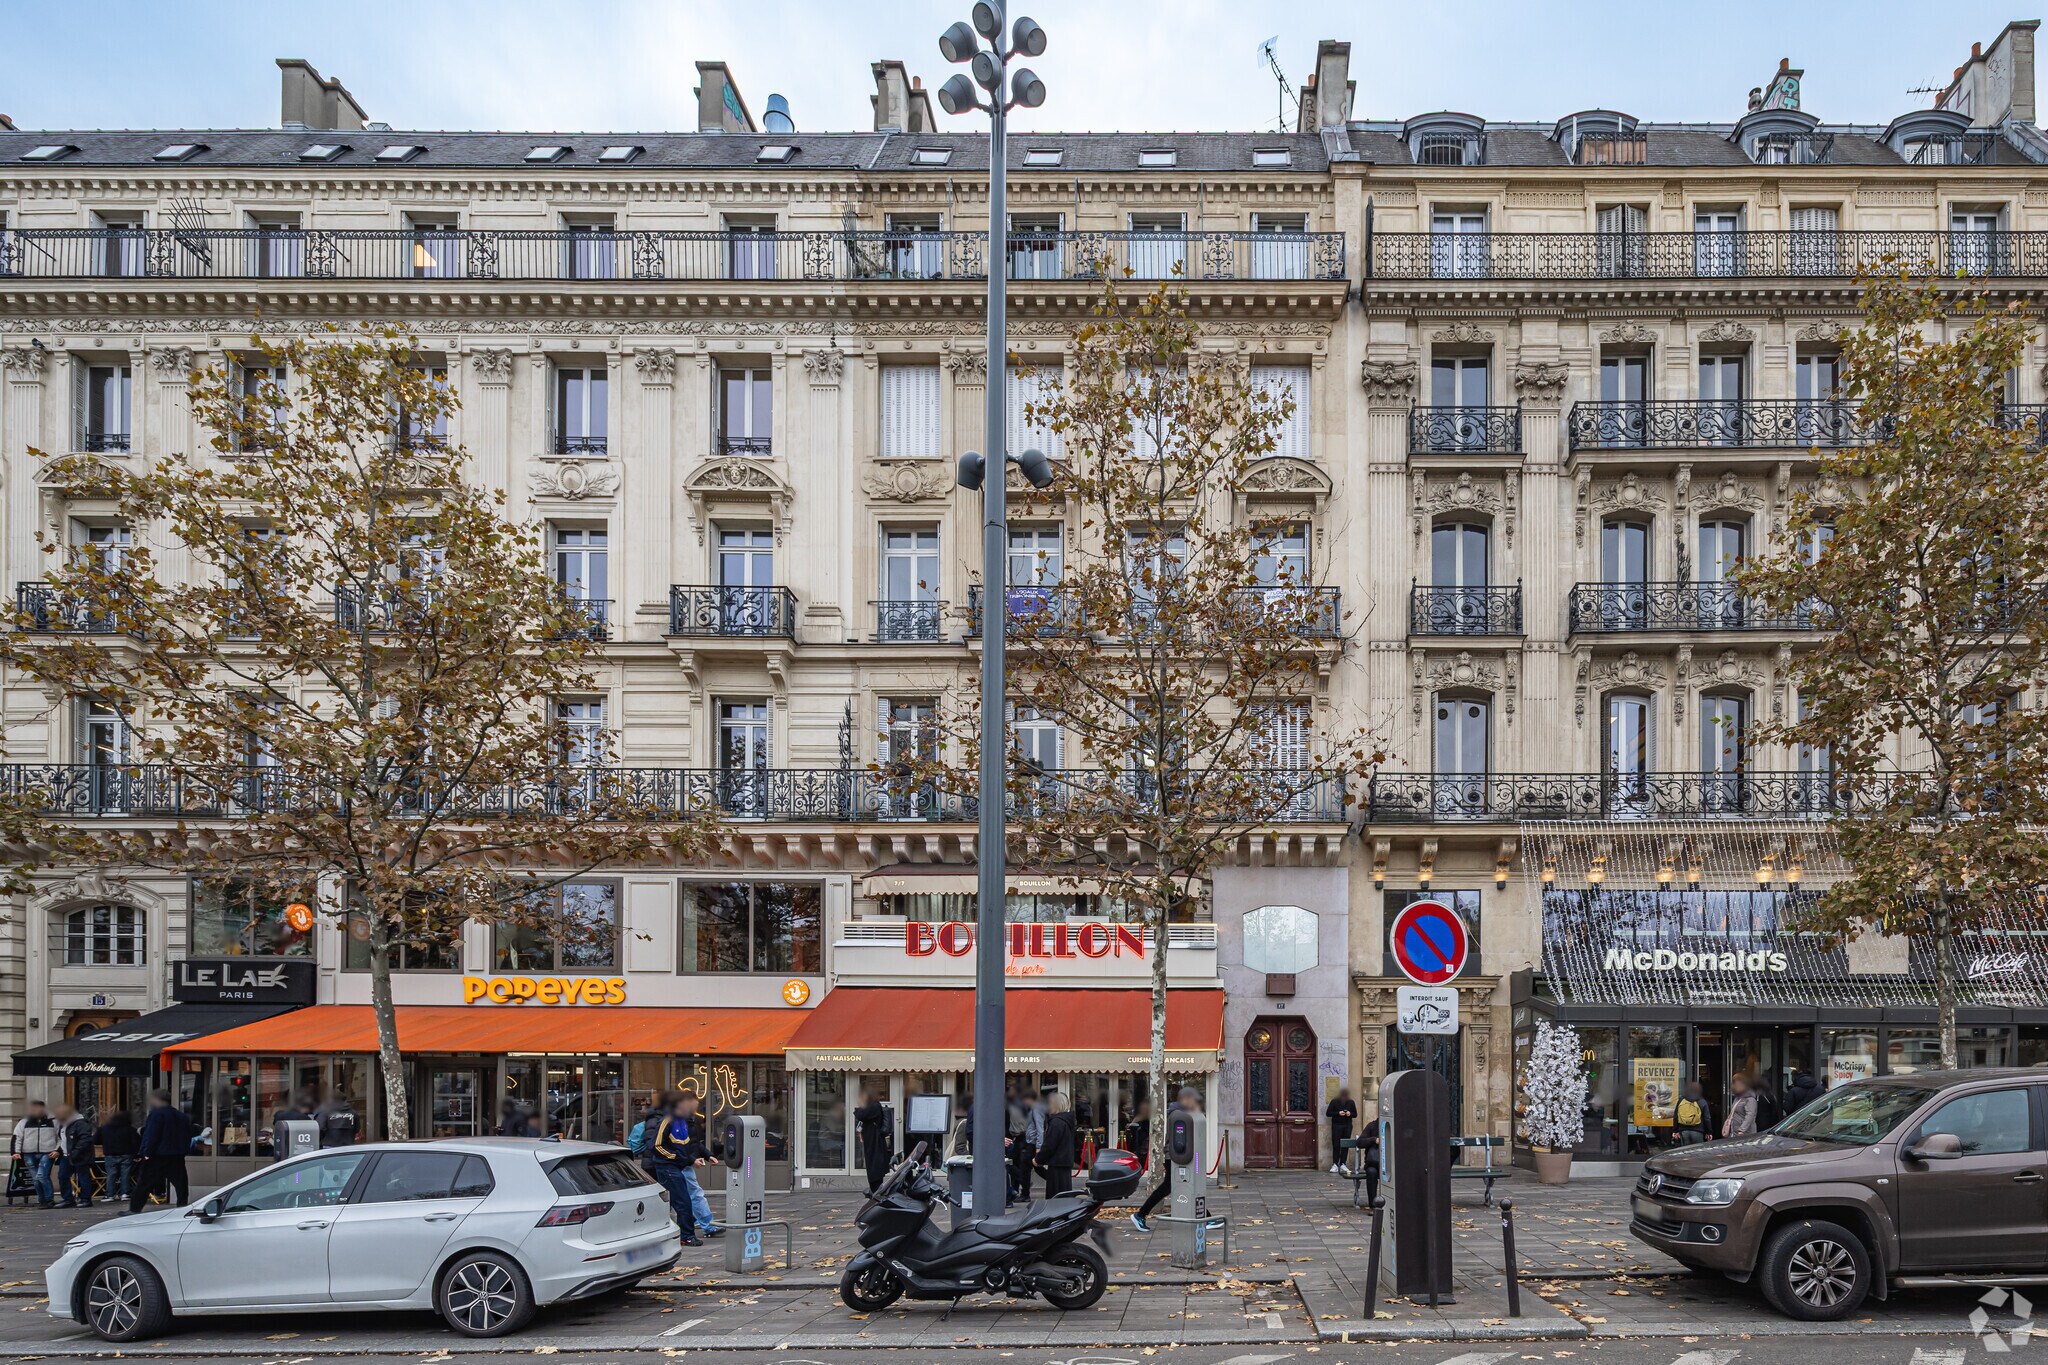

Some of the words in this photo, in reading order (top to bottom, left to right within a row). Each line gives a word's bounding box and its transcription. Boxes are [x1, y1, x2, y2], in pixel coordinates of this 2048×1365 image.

[1019, 879, 1051, 887] BOUILLON
[905, 920, 1144, 959] BOILLON
[1603, 949, 1787, 972] McDonald's
[181, 963, 217, 987] LE
[222, 963, 280, 988] LAB
[80, 1032, 187, 1041] CBD
[48, 1062, 74, 1074] Quality
[84, 1062, 116, 1074] Nothing
[1834, 1061, 1866, 1072] McCrispy
[1638, 1067, 1675, 1077] REVENEZ
[1834, 1071, 1853, 1080] Spicy
[298, 1133, 311, 1143] 03
[750, 1129, 760, 1138] 02
